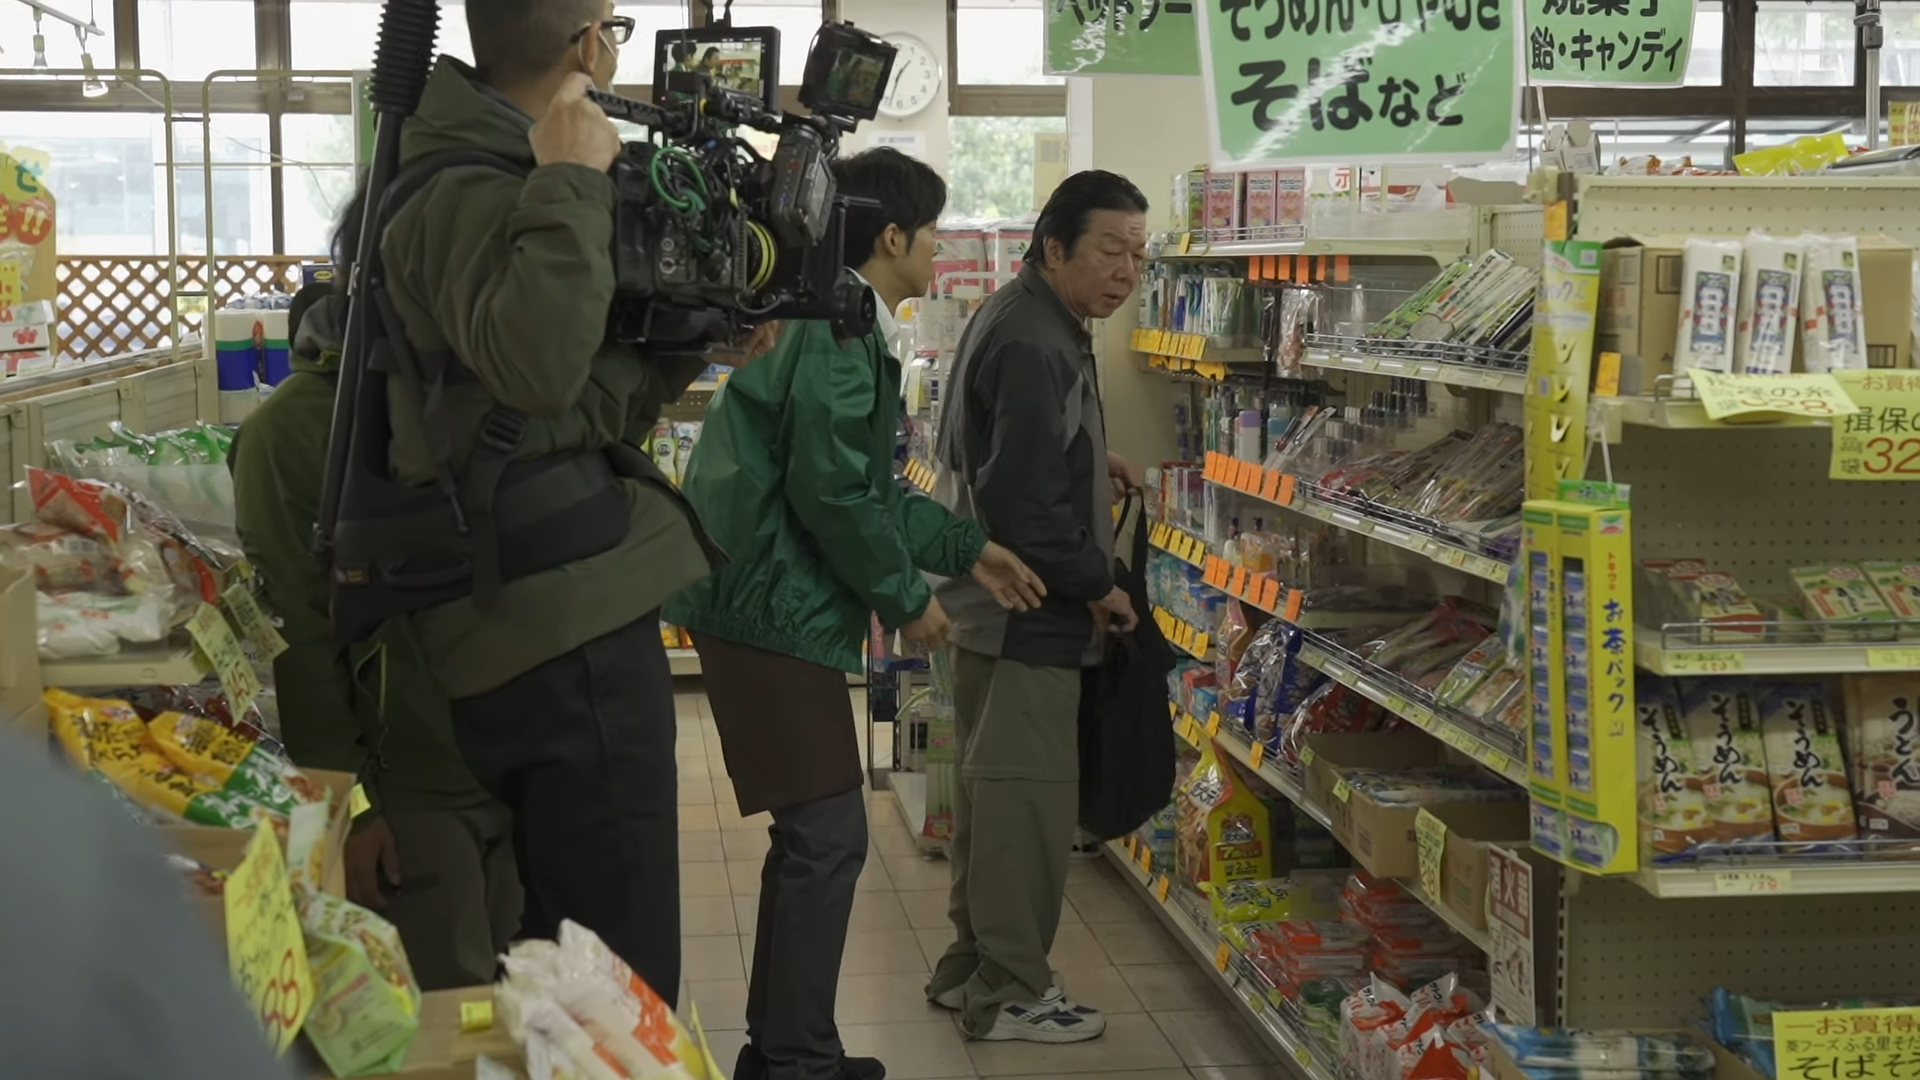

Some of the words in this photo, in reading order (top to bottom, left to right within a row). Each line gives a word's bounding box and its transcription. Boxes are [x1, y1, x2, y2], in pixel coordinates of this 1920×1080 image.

[1531, 26, 1683, 72] 飴・キャンディ
[1231, 57, 1467, 131] そばなど
[1602, 598, 1627, 714] お茶パック
[1711, 694, 1742, 785] そうめん
[1786, 700, 1825, 789] そうめん
